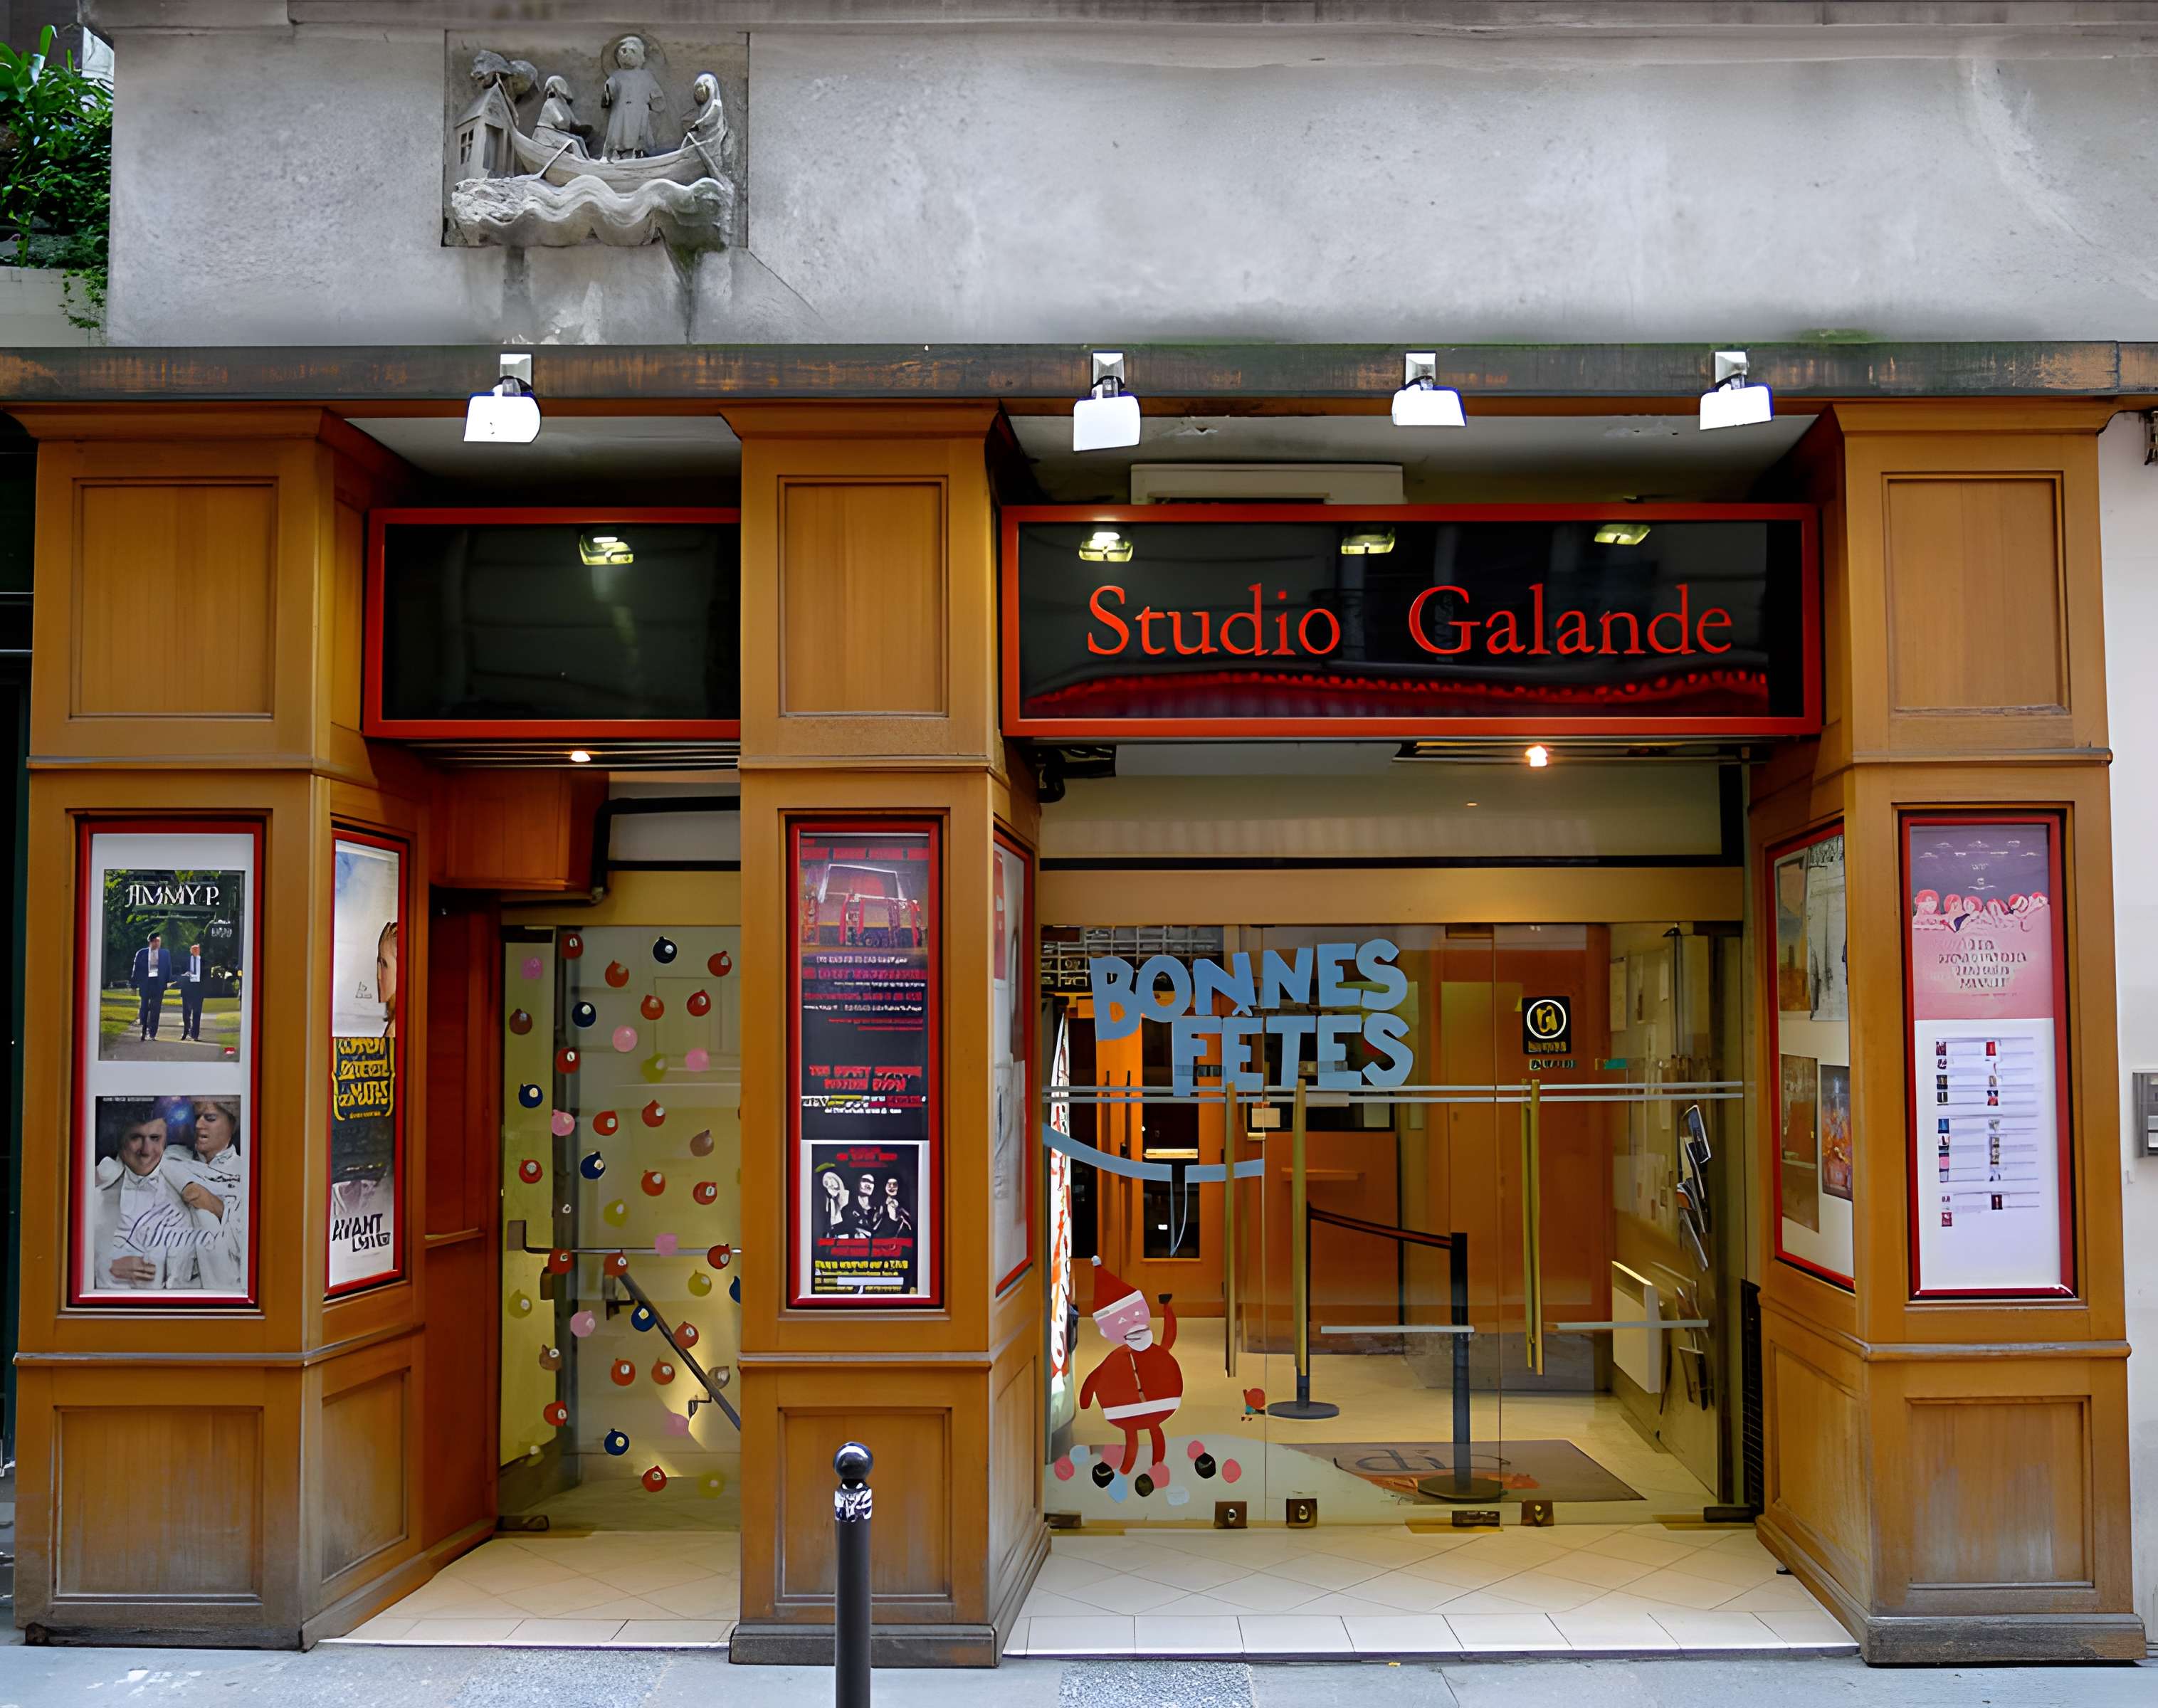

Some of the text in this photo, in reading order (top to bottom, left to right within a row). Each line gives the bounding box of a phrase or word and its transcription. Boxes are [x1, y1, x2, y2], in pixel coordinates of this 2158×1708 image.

[1087, 584, 1733, 656] Studio Galande
[1089, 939, 1409, 1040] BONNES
